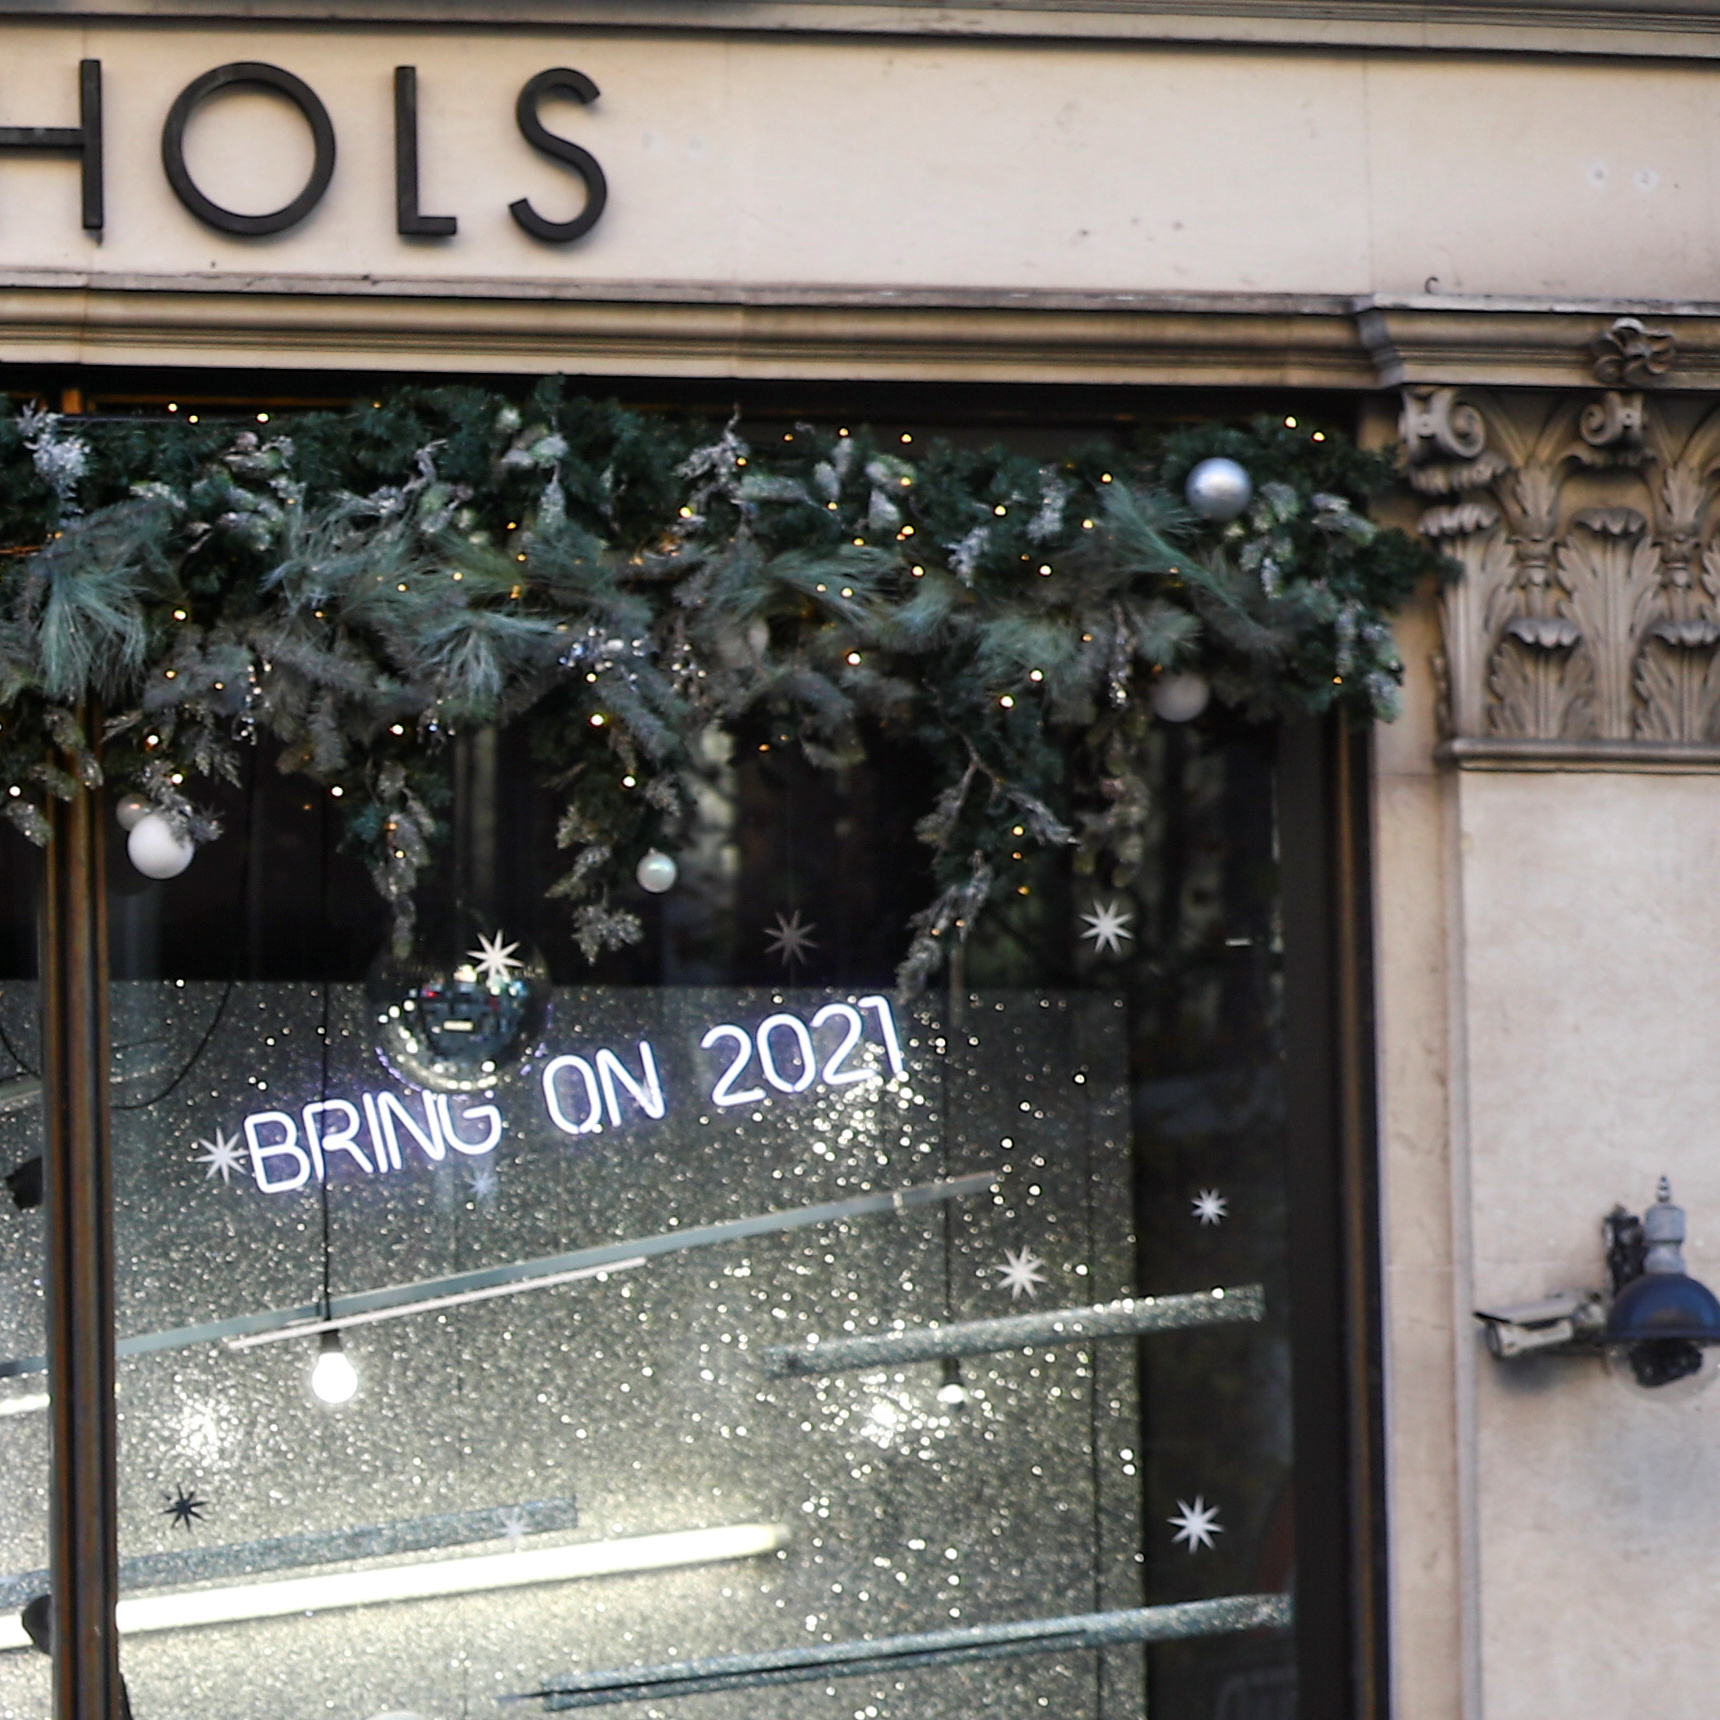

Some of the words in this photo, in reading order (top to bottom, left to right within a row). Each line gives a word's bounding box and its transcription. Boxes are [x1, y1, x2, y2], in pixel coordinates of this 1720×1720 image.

[244, 1090, 504, 1194] BRING
[541, 1041, 666, 1136] ON
[700, 995, 905, 1106] 2021
